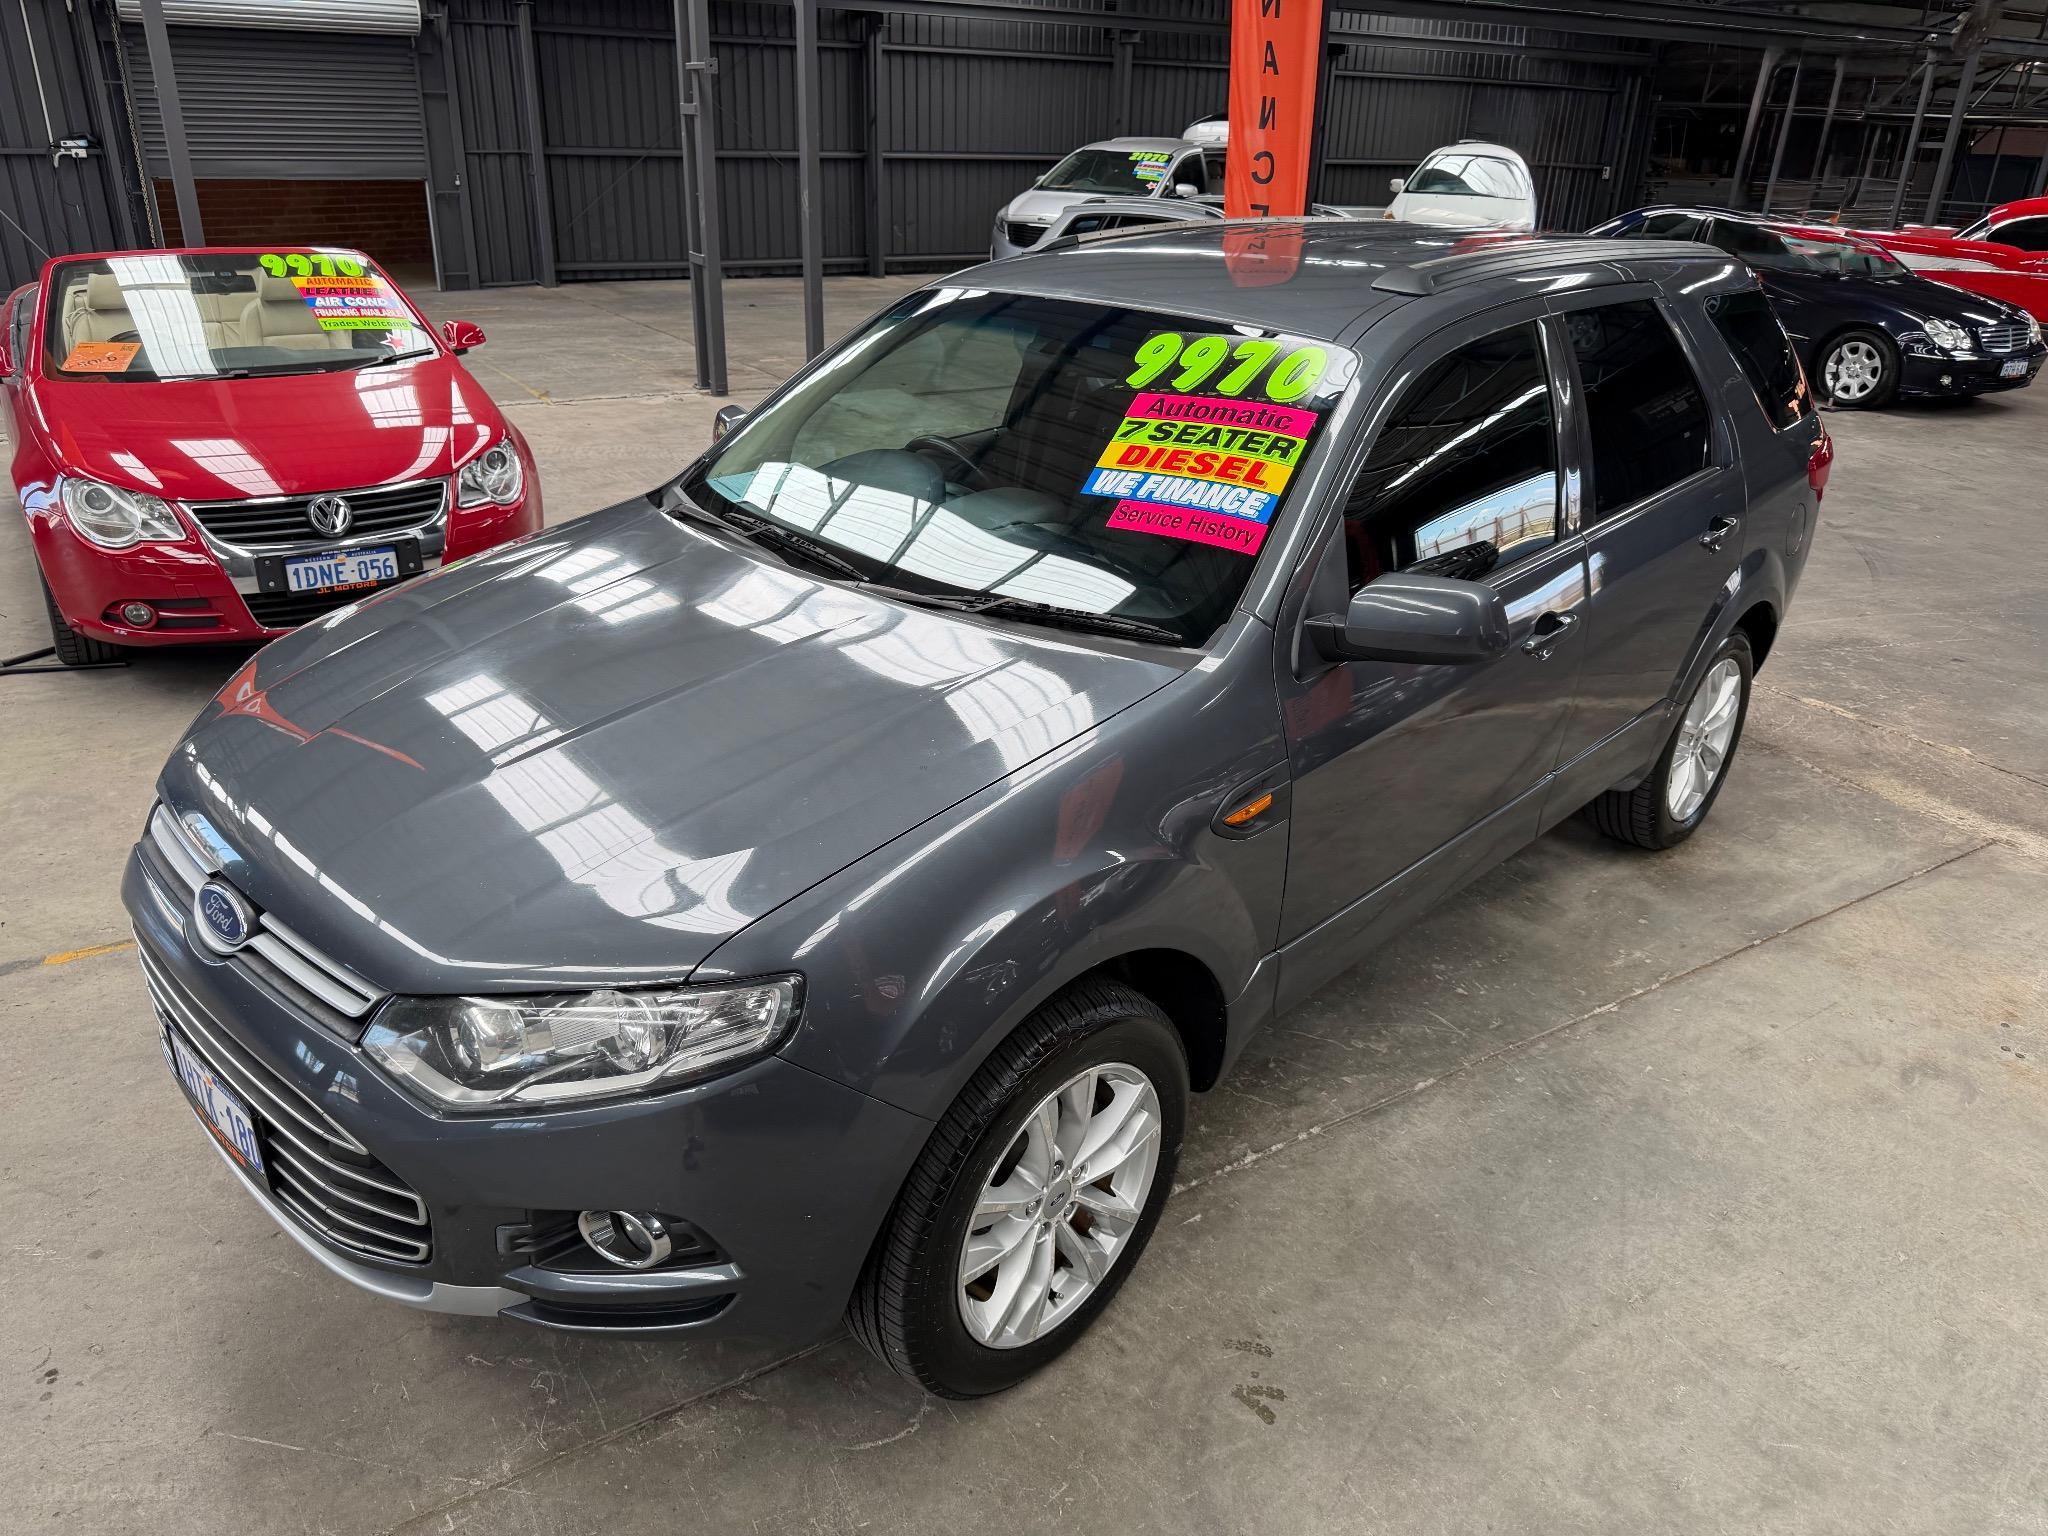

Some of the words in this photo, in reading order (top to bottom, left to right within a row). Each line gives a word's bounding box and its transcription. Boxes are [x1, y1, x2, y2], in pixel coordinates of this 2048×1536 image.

[1128, 152, 1169, 163] 21970
[260, 254, 364, 278] 9970
[306, 278, 373, 287] AUTOMATIC
[315, 297, 343, 307] AIR
[344, 297, 388, 308] COND
[315, 308, 360, 317] FINANCING
[360, 308, 405, 318] AVAILABLE
[322, 320, 359, 328] Trades
[361, 320, 409, 328] Welcome
[1126, 332, 1329, 404] 9970
[1145, 397, 1294, 431] Automatic
[1117, 420, 1149, 441] 7
[1148, 421, 1301, 461] SEATER
[1115, 445, 1269, 490] DIESEL
[1091, 470, 1139, 497] WE
[1136, 475, 1271, 518] FINANCE
[1115, 504, 1183, 529] Service
[1186, 514, 1257, 548] History
[292, 557, 395, 589] 1DNE-056
[334, 580, 378, 592] MOTORS
[205, 893, 233, 932] Ford
